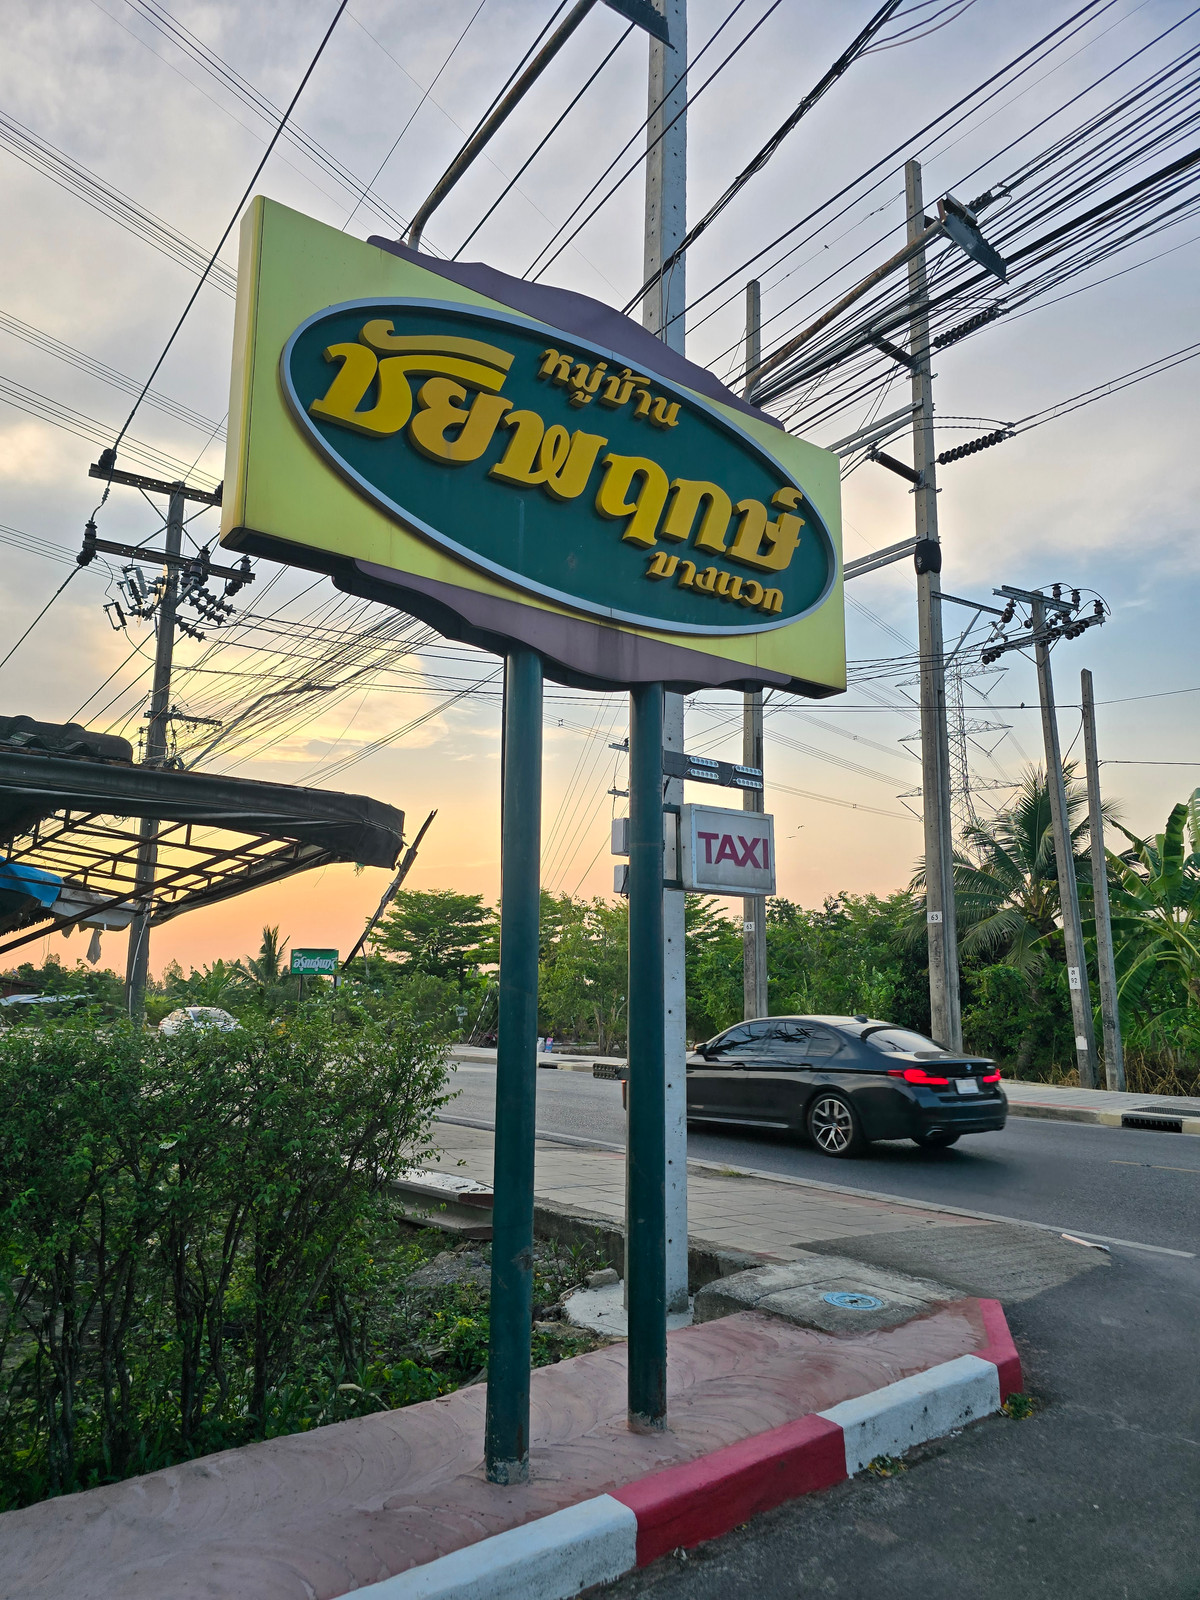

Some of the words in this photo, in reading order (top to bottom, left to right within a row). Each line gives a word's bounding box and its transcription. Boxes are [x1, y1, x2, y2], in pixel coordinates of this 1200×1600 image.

[537, 347, 682, 431] หมู่บ้าน
[308, 319, 806, 573] ชัยพฤกษ์
[645, 551, 784, 616] บางแวก
[697, 831, 770, 870] TAXI
[930, 913, 939, 921] 63
